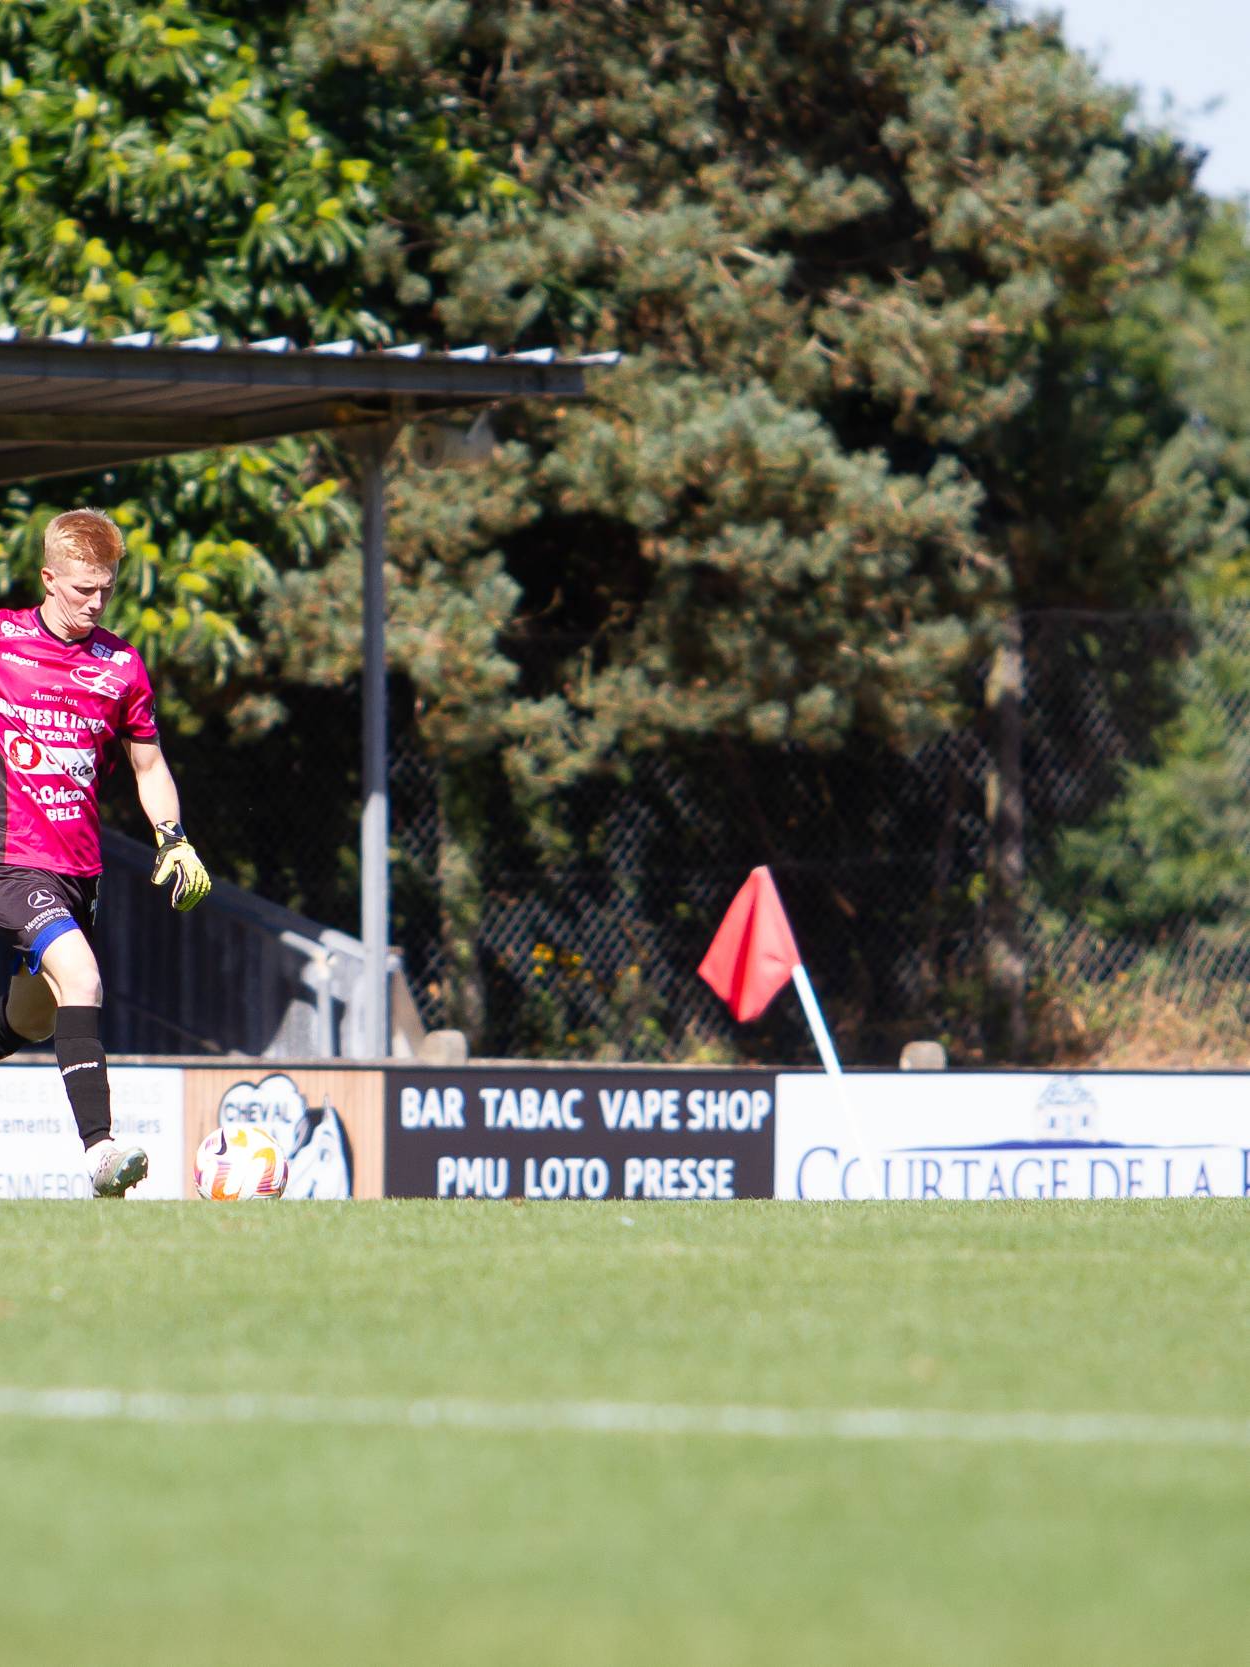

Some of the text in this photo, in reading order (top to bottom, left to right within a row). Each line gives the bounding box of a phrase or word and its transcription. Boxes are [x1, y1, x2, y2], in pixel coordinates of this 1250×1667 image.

[54, 710, 68, 728] LE
[45, 805, 82, 821] BELZ
[224, 1101, 292, 1124] CHEVAL
[400, 1087, 772, 1132] BAR TABAC VAPE SHOP
[437, 1156, 735, 1198] PMU LOTO PRESSE
[1088, 1158, 1144, 1199] DE
